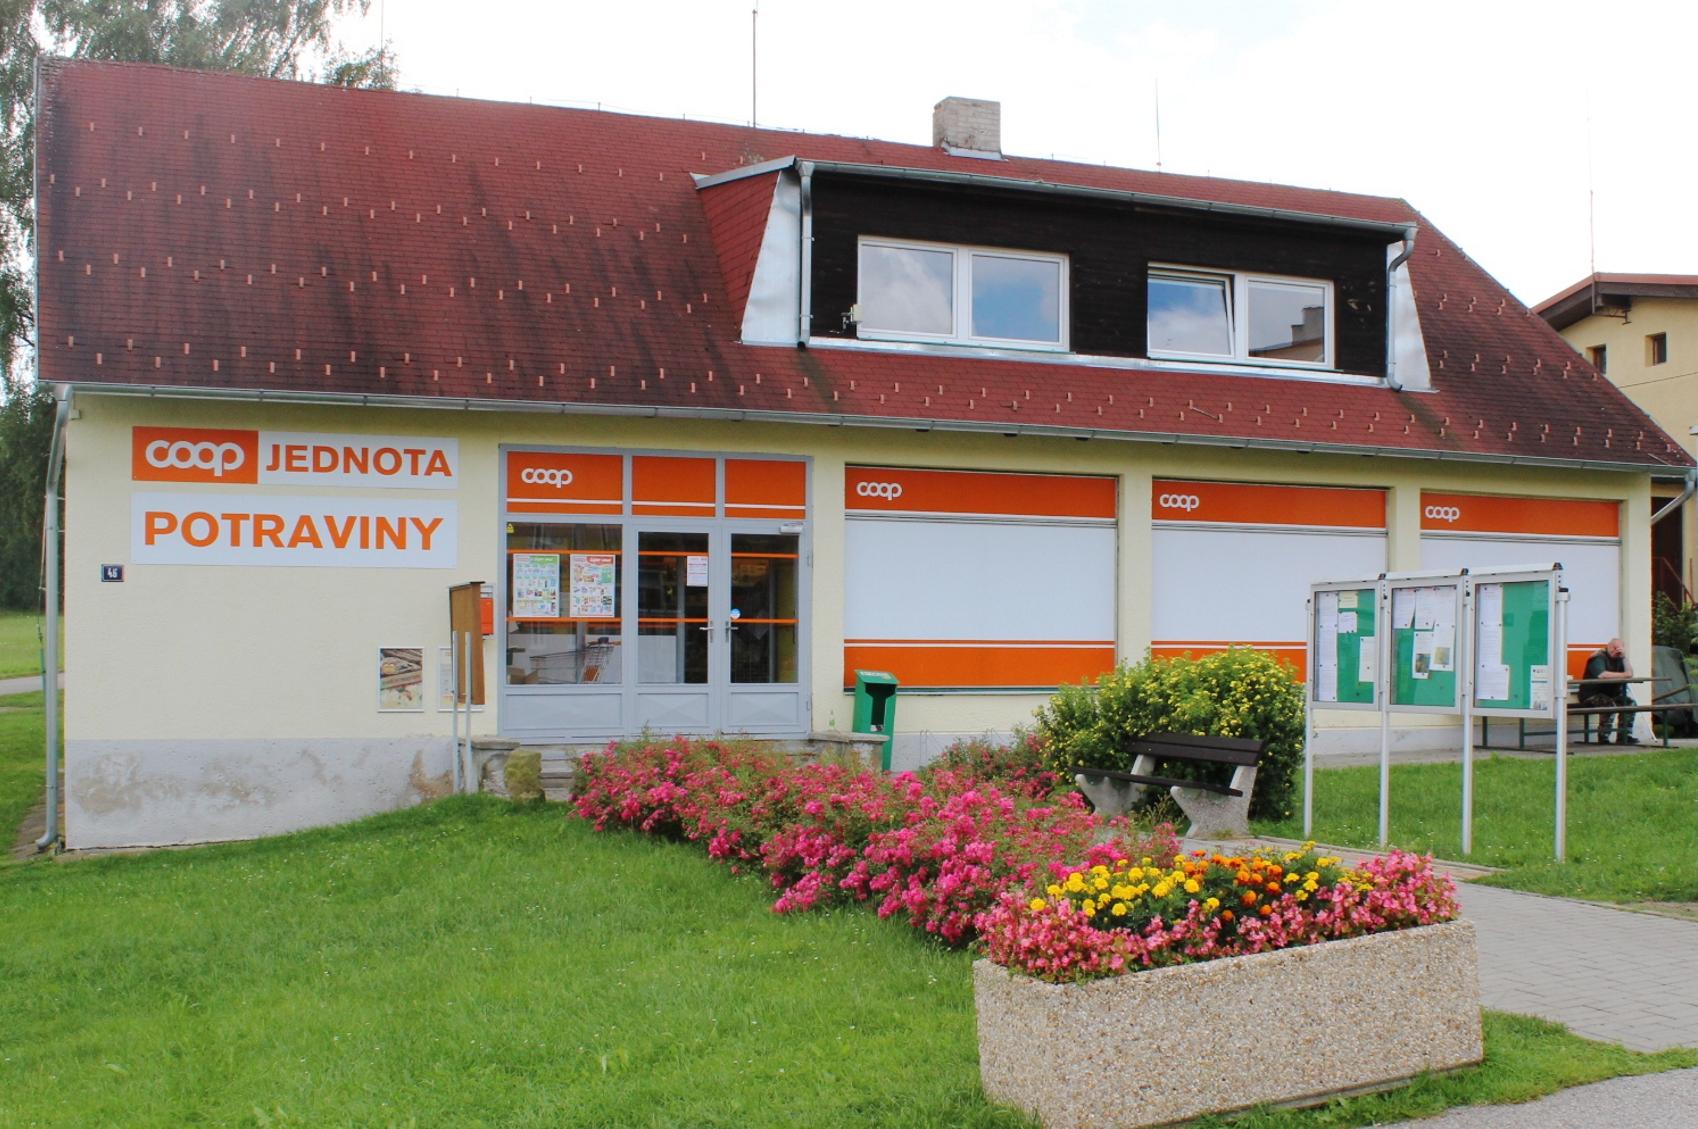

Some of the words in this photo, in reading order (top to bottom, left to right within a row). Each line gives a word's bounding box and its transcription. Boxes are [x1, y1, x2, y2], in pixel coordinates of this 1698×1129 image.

[145, 440, 245, 477] coop
[266, 443, 453, 477] JEDNOTA
[522, 468, 573, 488] coop
[856, 481, 903, 501] coop
[1159, 494, 1200, 512] coop
[1425, 505, 1460, 522] coop
[145, 511, 443, 551] POTRAVINY
